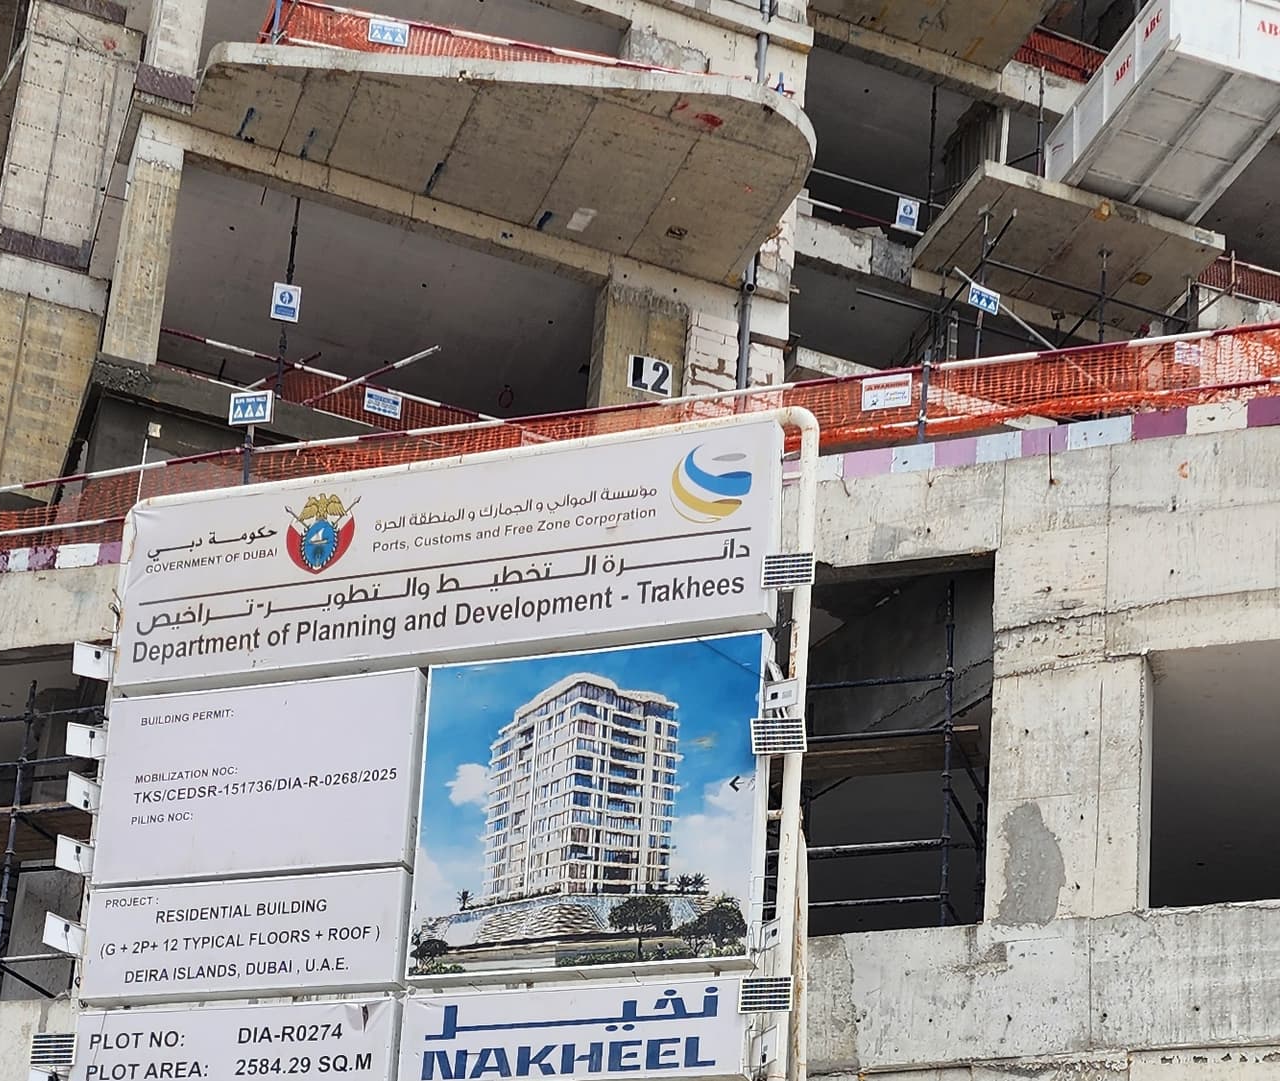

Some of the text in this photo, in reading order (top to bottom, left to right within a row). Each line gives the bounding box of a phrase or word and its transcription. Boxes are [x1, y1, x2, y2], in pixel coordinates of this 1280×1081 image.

[1143, 9, 1163, 41] ABC
[1114, 54, 1132, 85] ABC
[632, 356, 669, 395] L2
[600, 485, 657, 501] مؤسسة
[372, 508, 657, 553] Ports, Customs and Free Zone Corporation
[145, 547, 278, 574] GOVERNMENT OF DUBAI
[132, 627, 260, 665] Department
[267, 622, 291, 646] of
[296, 614, 396, 644] Planning
[404, 607, 447, 632] and
[455, 586, 613, 626] Development
[637, 575, 745, 605] Trakhees
[141, 709, 234, 726] BUILDING PERMIT:
[133, 768, 397, 804] TKS/CEDSR-151736/DIA-R-0268/2025
[135, 766, 238, 784] MOBILIZATION NOC:
[131, 811, 193, 825] PILING NOC:
[105, 896, 153, 909] PROJECT
[156, 898, 328, 923] RESIDENTIAL BUILDING
[100, 943, 116, 960] (G
[120, 945, 128, 953] +
[163, 939, 178, 952] 12
[183, 934, 244, 950] TYPICAL
[249, 929, 311, 946] FLOORS
[315, 930, 323, 940] +
[328, 926, 372, 941] ROOF
[124, 968, 169, 984] DEIRA
[173, 963, 241, 980] ISLANDS,
[246, 959, 292, 976] DUBAI
[305, 957, 349, 972] U.A.E.
[89, 1022, 343, 1050] PLOT NO: DIA-R0274
[85, 1053, 372, 1081] PLOT AREA: 2584.29 SQ.M
[421, 1036, 716, 1080] NAKHEEL
